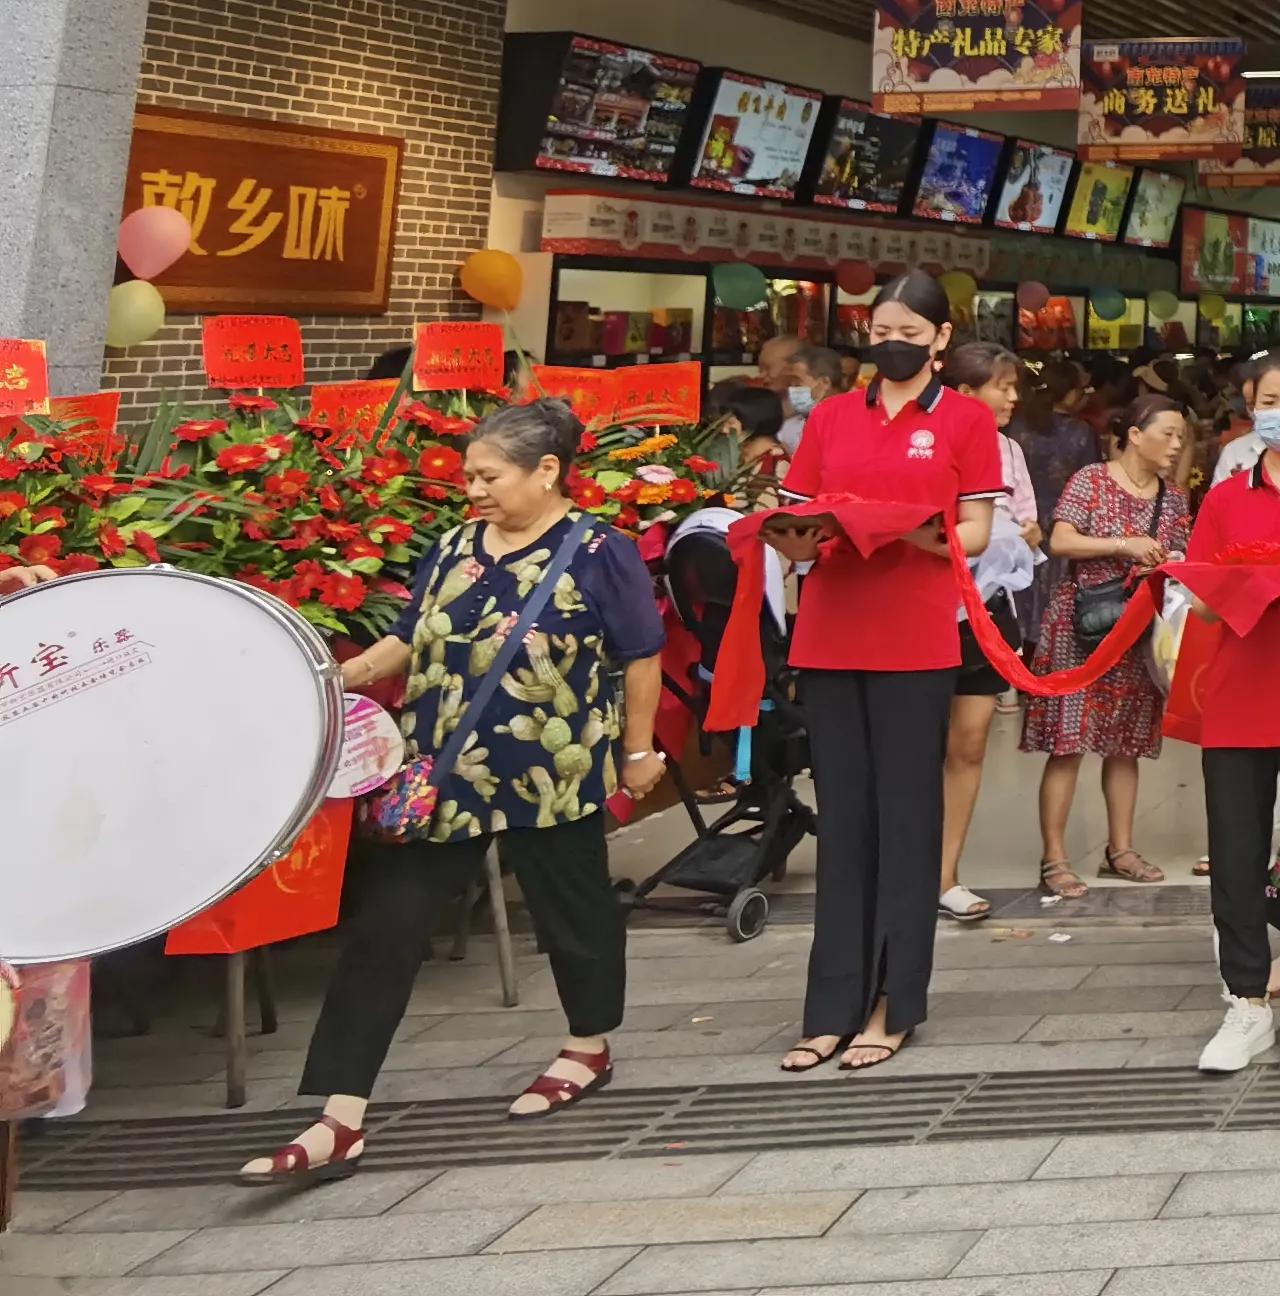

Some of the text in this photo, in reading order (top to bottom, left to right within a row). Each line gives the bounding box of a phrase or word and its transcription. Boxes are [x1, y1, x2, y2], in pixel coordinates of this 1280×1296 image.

[892, 24, 1065, 58] 特产礼品专家
[1103, 85, 1219, 115] 商务送礼
